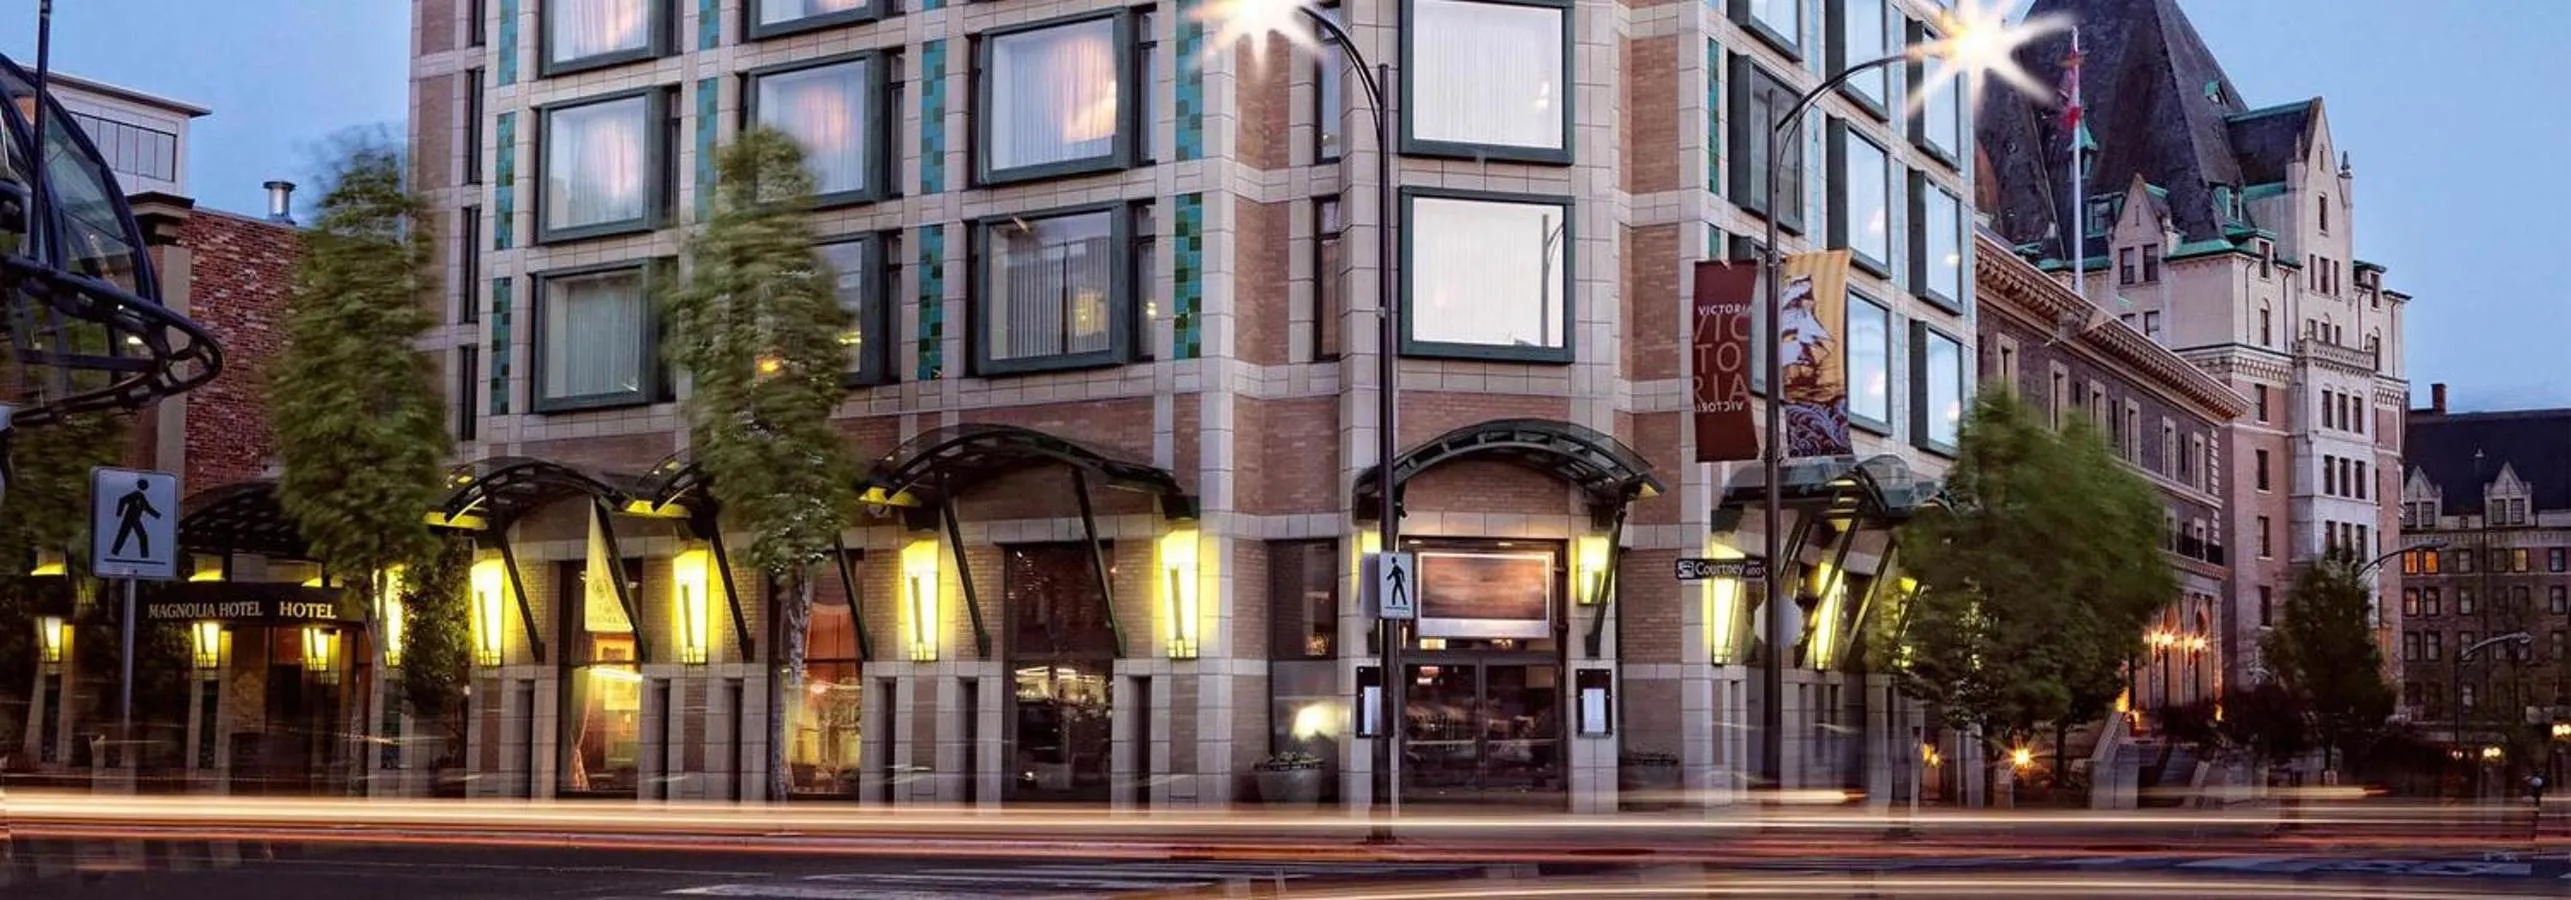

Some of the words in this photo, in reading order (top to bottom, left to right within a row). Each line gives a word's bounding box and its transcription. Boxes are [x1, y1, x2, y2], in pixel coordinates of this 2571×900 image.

[1695, 342, 1742, 373] TO
[1695, 562, 1745, 577] Courtney
[148, 602, 216, 619] MAGNOLIA
[218, 601, 263, 617] HOTEL
[279, 601, 337, 619] HOTEL
